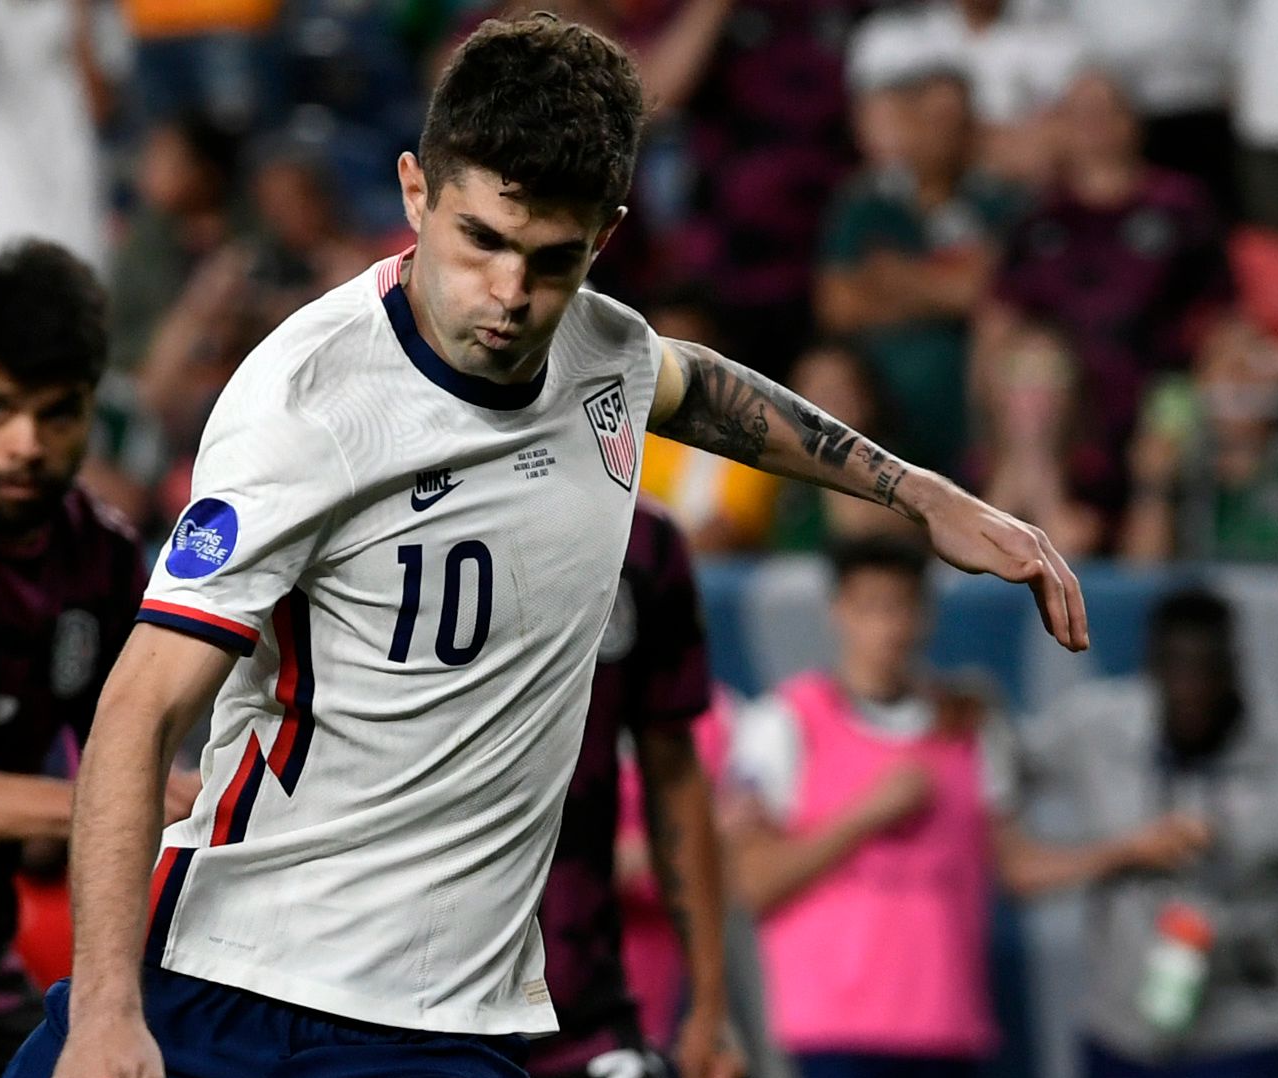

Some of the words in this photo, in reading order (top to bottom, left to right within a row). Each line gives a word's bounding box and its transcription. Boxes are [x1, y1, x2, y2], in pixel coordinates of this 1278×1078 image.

[590, 391, 623, 433] USA
[416, 467, 452, 494] NIKE
[387, 539, 493, 666] 10
